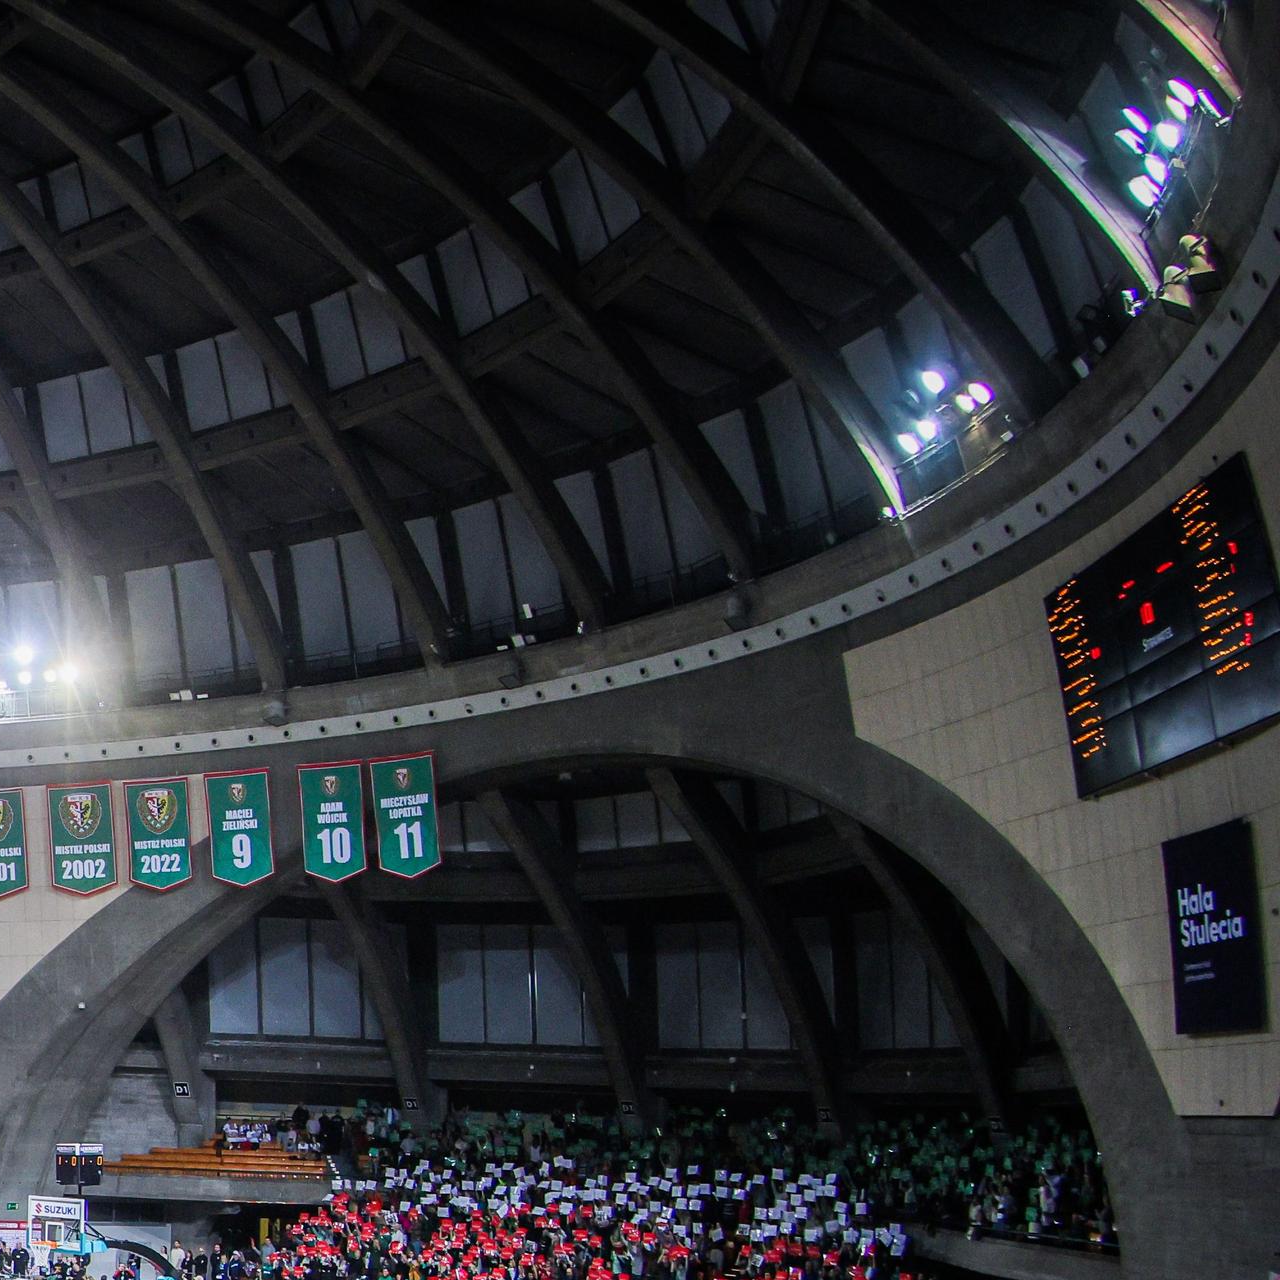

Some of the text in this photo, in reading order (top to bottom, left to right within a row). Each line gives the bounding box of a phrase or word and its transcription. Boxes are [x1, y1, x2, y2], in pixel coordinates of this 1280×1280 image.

[225, 809, 253, 821] MACIEJ
[320, 801, 343, 813] ADAM
[317, 811, 348, 825] WÓJCIK
[134, 838, 186, 851] MISTRZ POLSKI
[316, 826, 352, 864] 10
[393, 820, 424, 859] 11
[55, 844, 111, 855] MISTRZ POLSKI
[231, 833, 253, 869] 9
[61, 859, 106, 879] 2002
[140, 854, 180, 874] 2022
[1177, 883, 1215, 917] Hala
[1180, 909, 1246, 948] Stulecia
[175, 1086, 188, 1094] D1
[44, 1204, 76, 1216] SUZUKI
